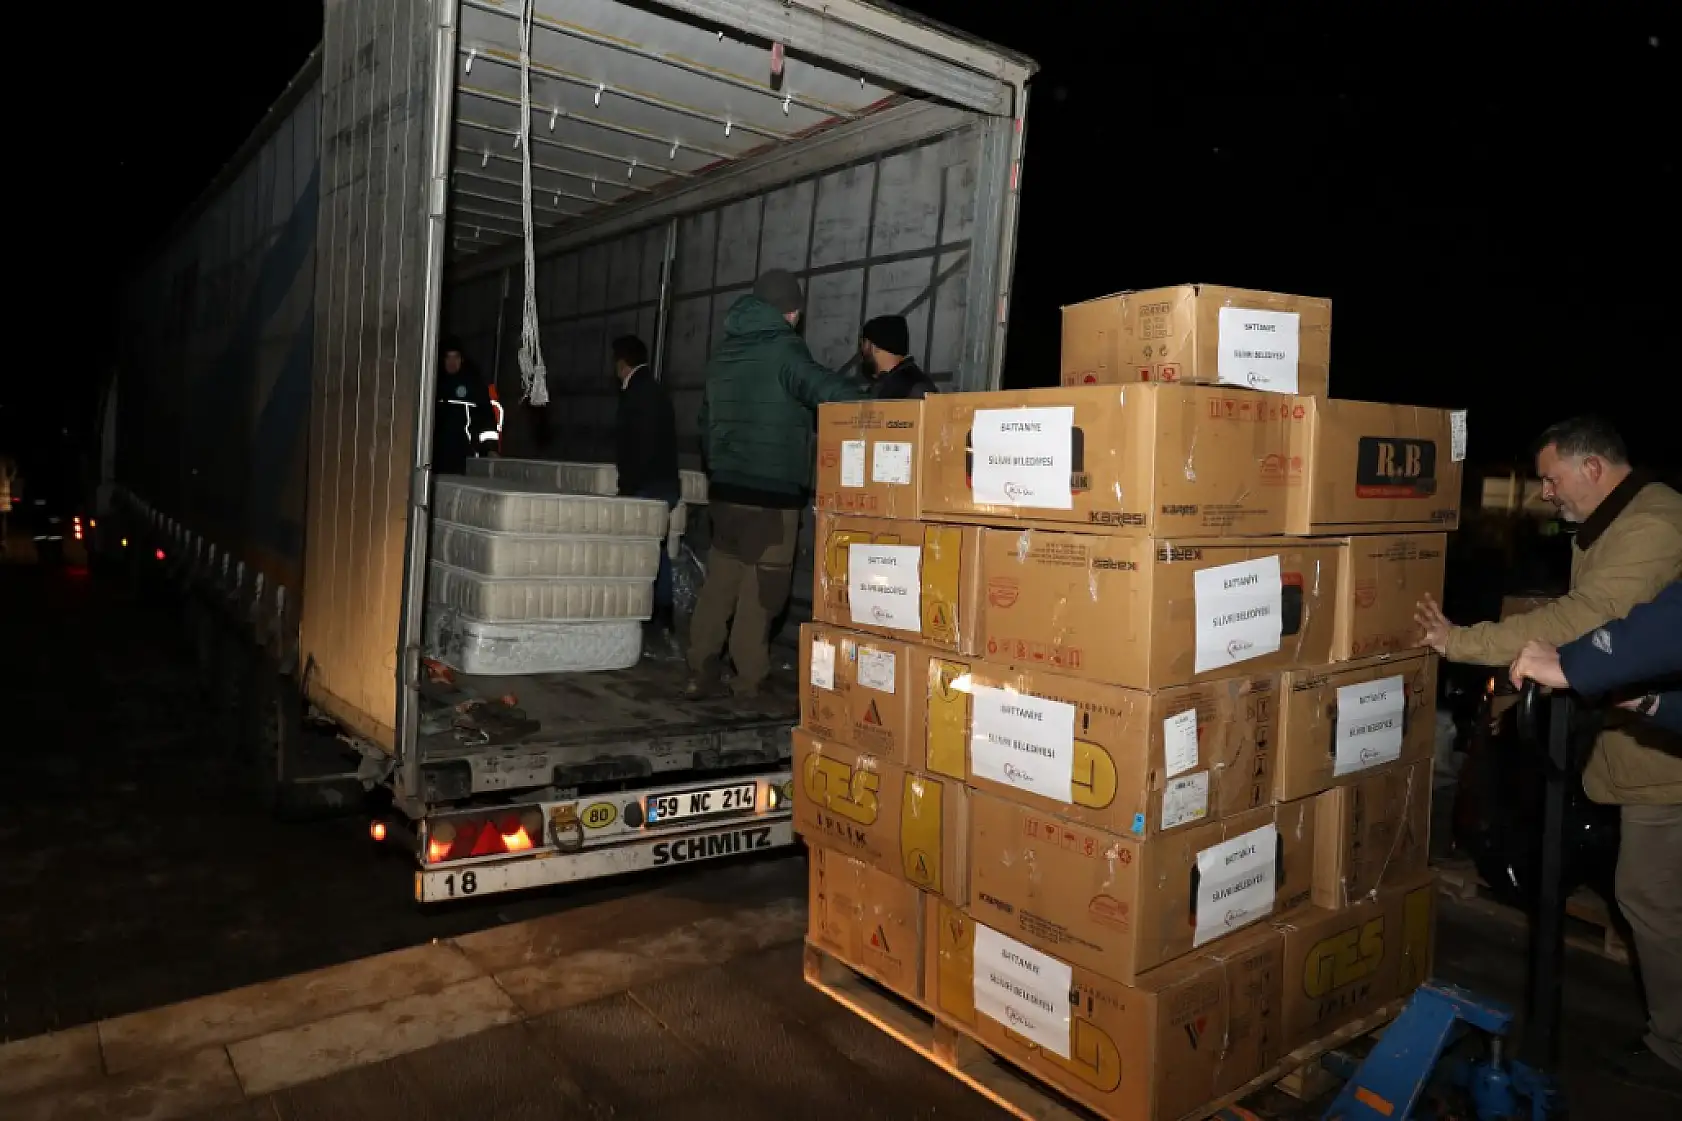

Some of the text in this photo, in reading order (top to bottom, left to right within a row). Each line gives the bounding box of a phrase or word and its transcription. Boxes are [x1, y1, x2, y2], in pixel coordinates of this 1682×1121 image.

[1376, 442, 1421, 477] R.B
[589, 808, 609, 823] 80
[656, 796, 678, 818] 59
[689, 793, 710, 813] NC
[722, 787, 753, 808] 214
[653, 828, 771, 864] SCHMITZ
[444, 870, 477, 896] 18
